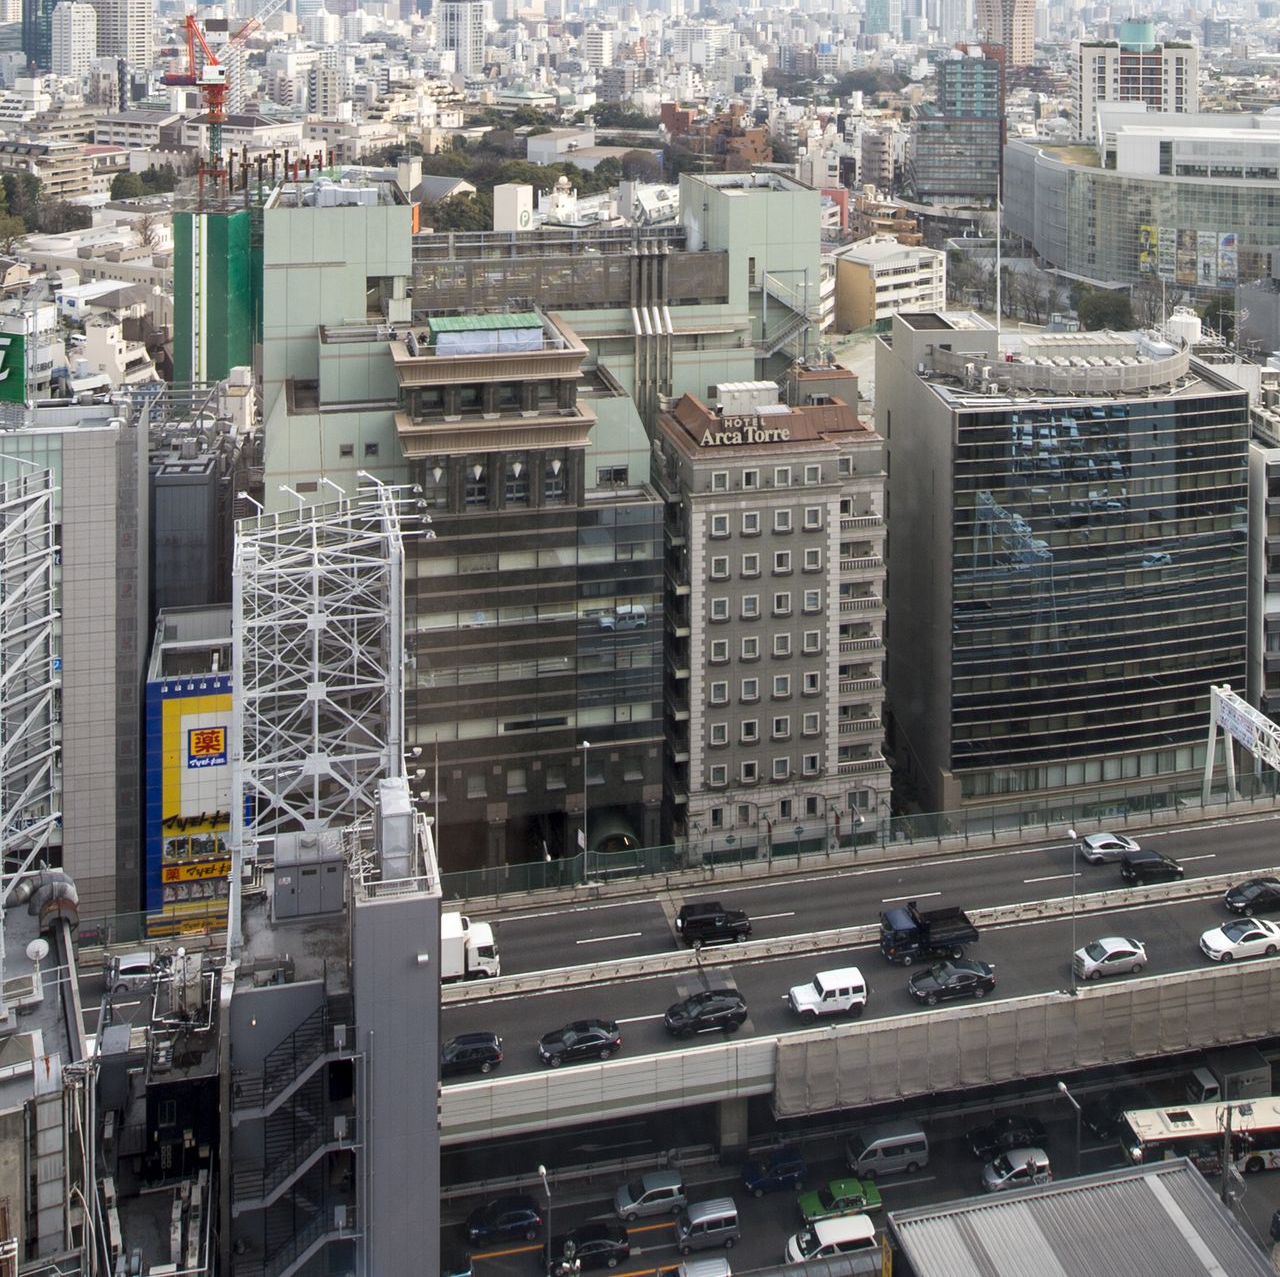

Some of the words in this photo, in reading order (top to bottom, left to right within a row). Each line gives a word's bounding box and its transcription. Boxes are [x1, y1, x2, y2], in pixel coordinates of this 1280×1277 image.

[723, 417, 767, 428] HOTEL
[700, 428, 742, 447] Arca
[743, 426, 791, 443] Torre
[194, 730, 221, 754] 薬
